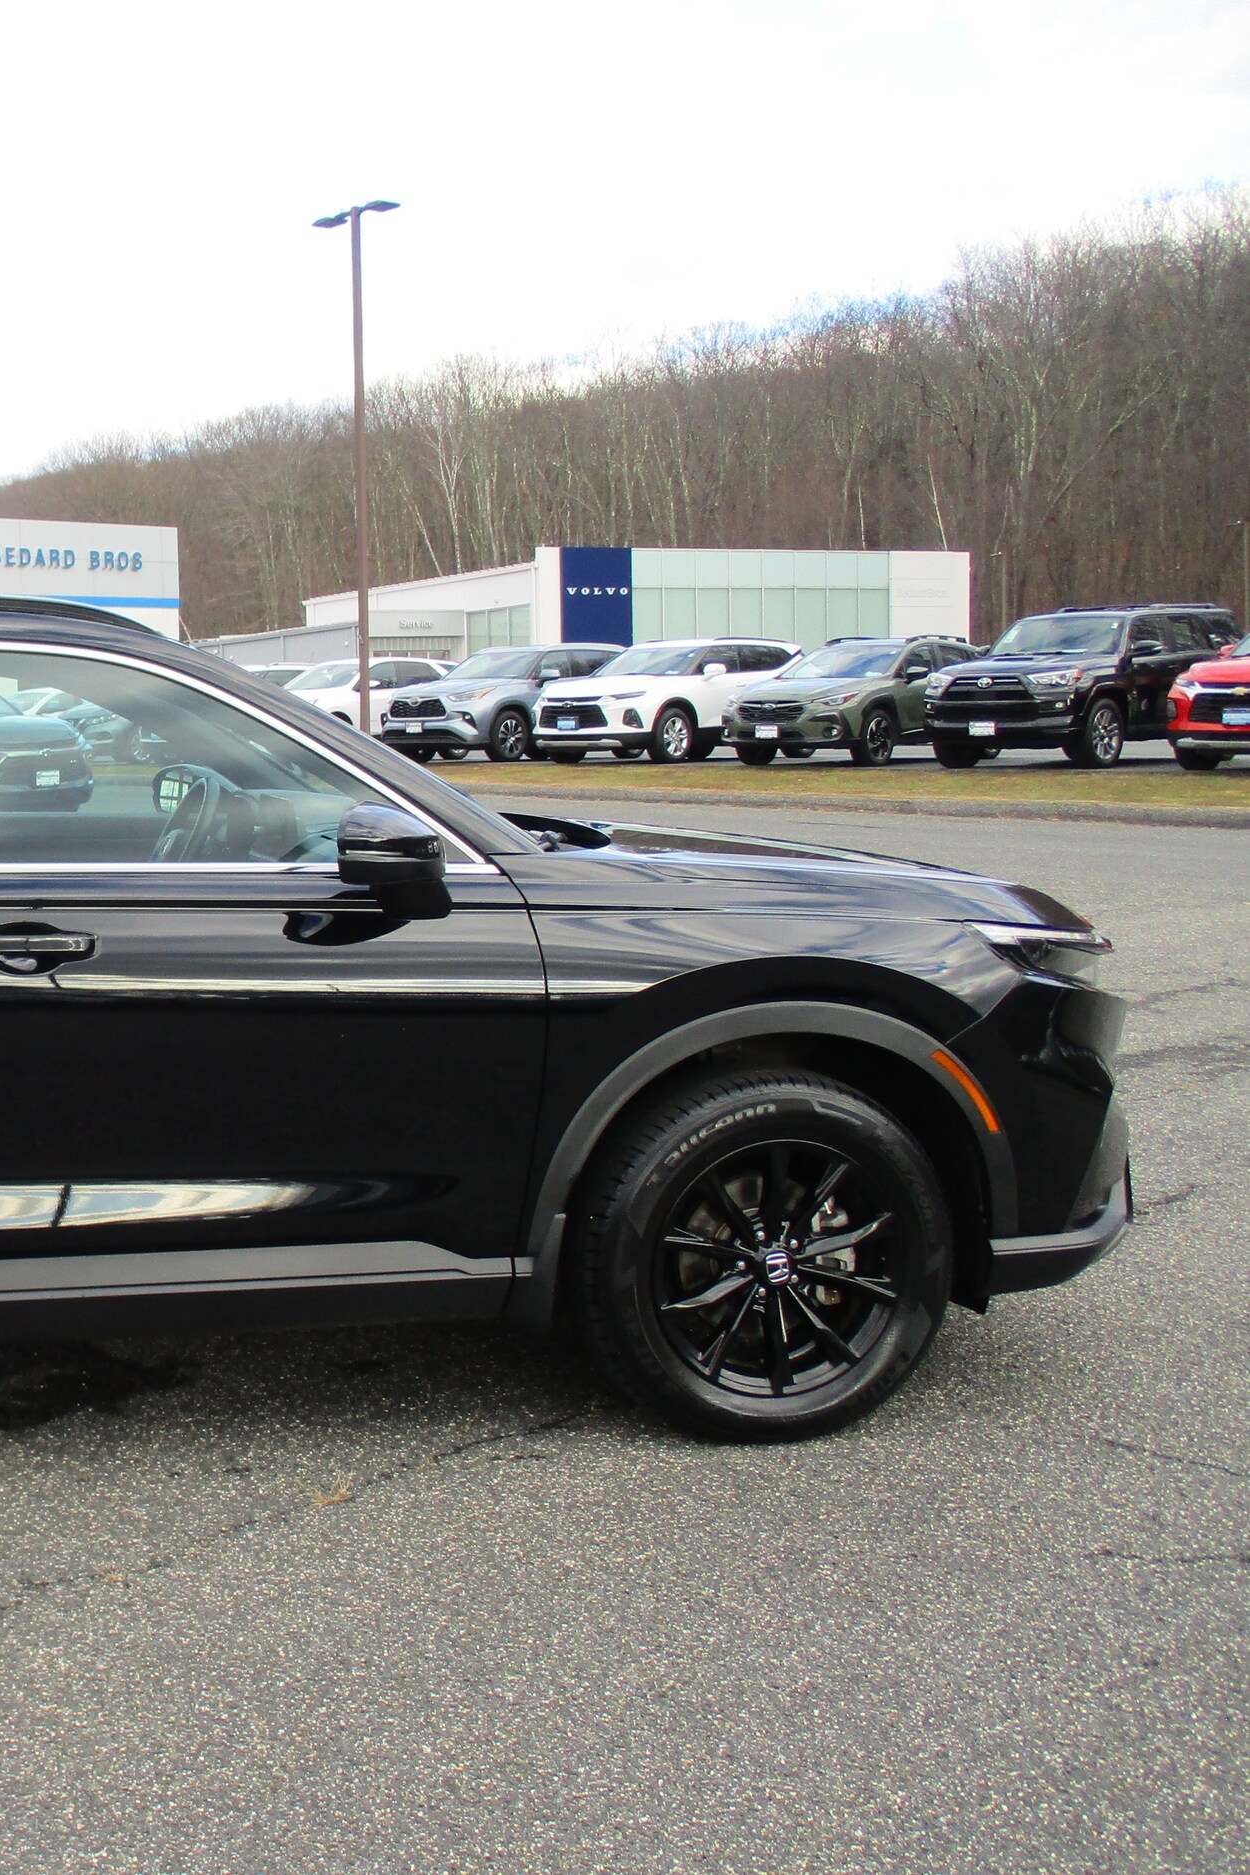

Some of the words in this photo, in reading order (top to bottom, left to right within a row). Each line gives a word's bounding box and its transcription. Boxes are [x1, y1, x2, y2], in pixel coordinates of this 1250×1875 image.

[89, 550, 143, 571] BROS
[566, 587, 629, 595] VOLVO
[399, 619, 435, 629] Service
